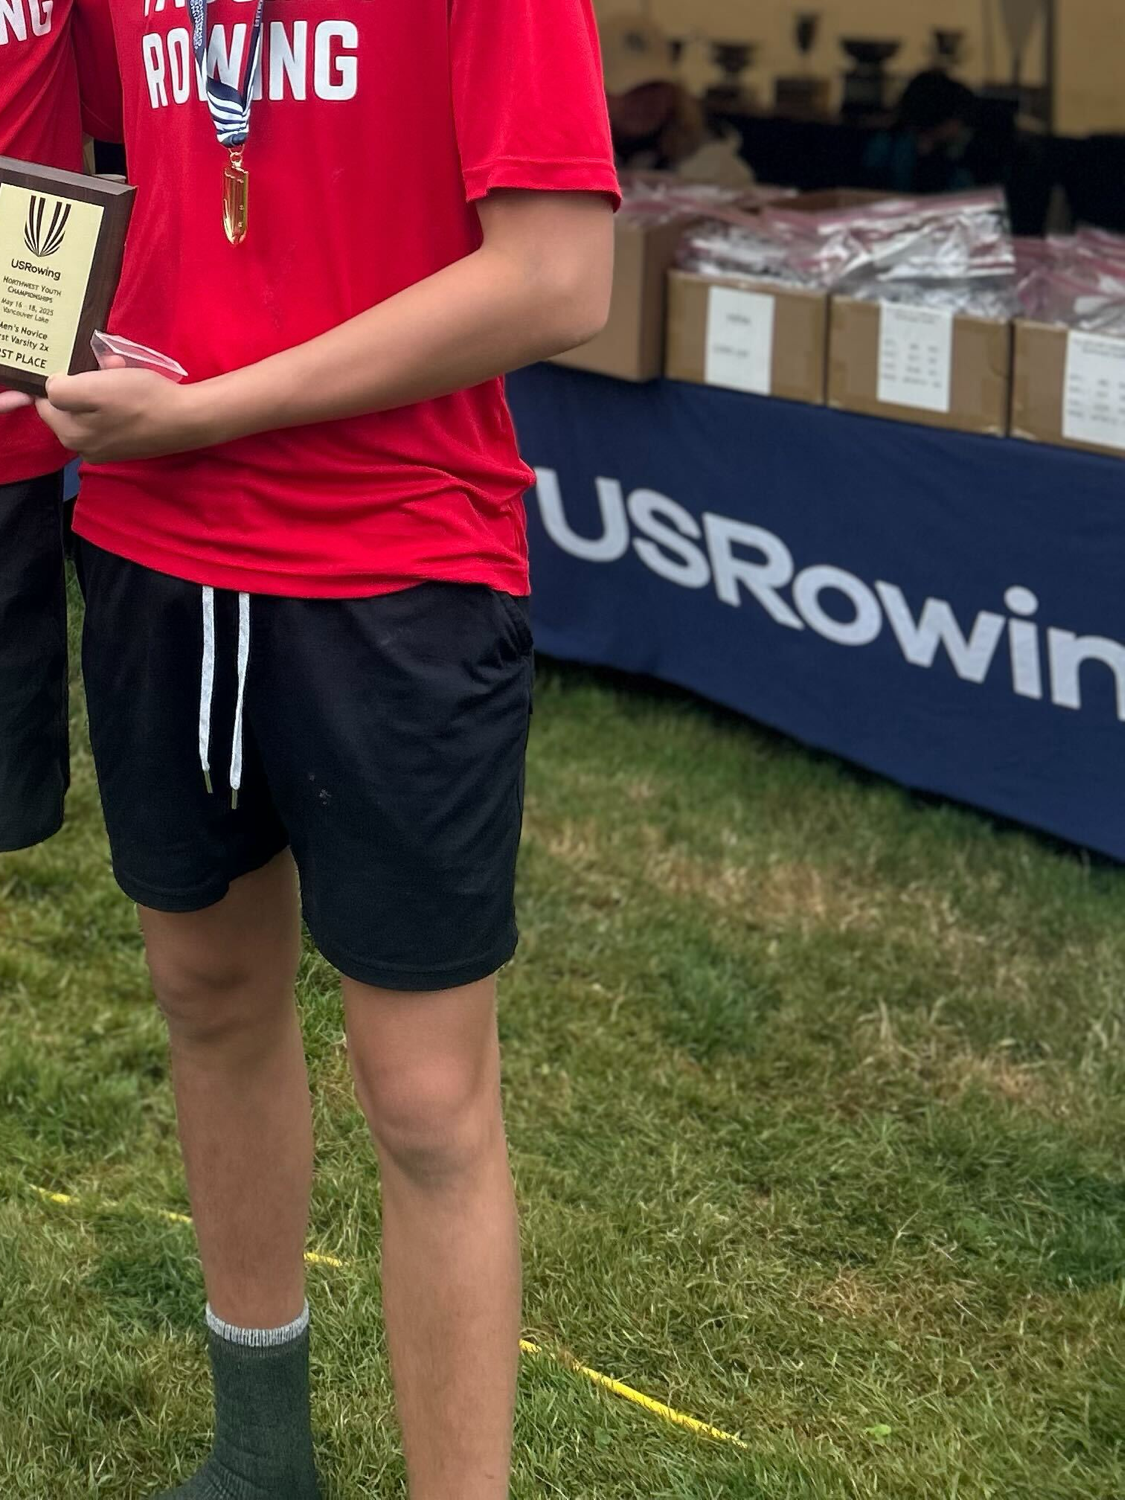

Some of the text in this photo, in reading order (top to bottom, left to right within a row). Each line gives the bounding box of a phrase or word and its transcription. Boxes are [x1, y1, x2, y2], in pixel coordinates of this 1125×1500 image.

[11, 258, 62, 281] USRowing
[1, 297, 14, 307] May
[39, 307, 55, 317] 2025
[3, 306, 50, 324] Vancouver Lake
[20, 327, 48, 341] Novice
[11, 335, 38, 350] Varsity
[39, 342, 50, 352] 2x
[15, 352, 47, 369] PLACE
[535, 466, 1125, 722] USRowin
